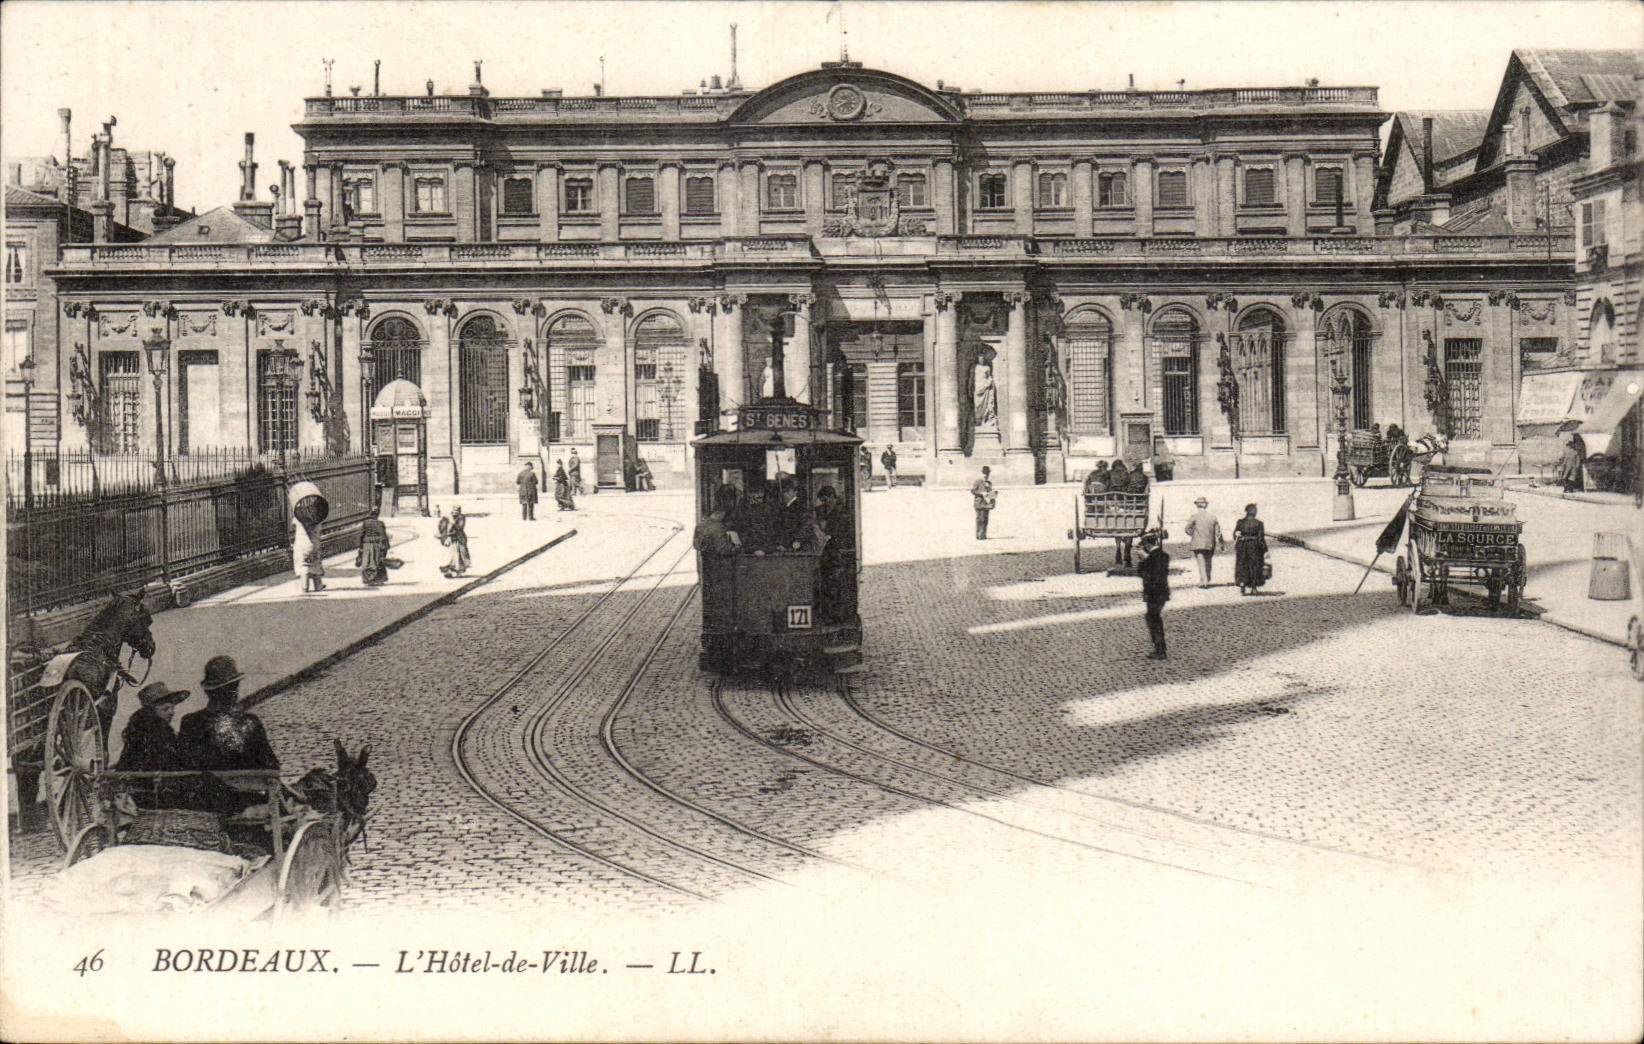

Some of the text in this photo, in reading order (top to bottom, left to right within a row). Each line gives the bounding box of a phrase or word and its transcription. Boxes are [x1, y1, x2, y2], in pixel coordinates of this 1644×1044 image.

[395, 409, 420, 417] MAGGI
[766, 413, 807, 428] GENES
[1438, 532, 1514, 545] LA SOURCE
